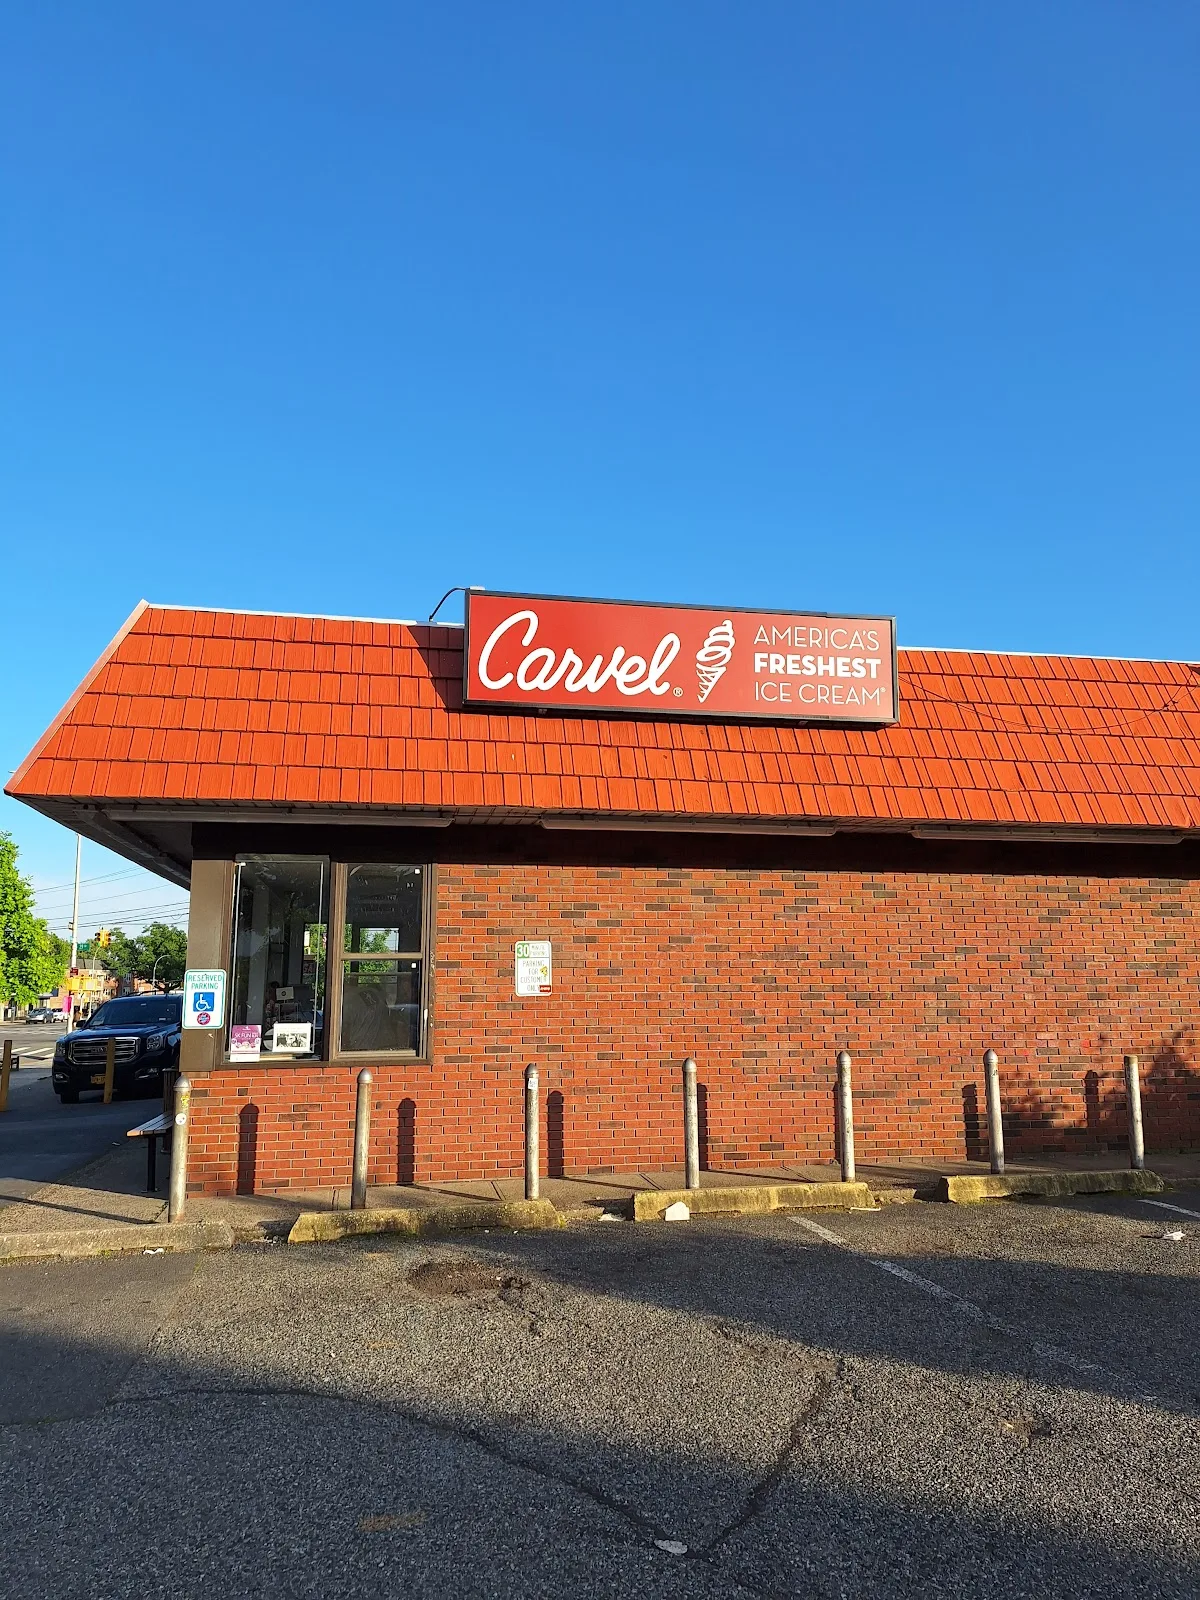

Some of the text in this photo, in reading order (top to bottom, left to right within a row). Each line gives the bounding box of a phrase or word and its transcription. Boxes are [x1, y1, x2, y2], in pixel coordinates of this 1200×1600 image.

[753, 624, 880, 651] AMERICA'S
[478, 609, 681, 696] Carvel
[754, 652, 882, 679] FRESHEST
[755, 681, 792, 703] ICE
[517, 944, 529, 957] 30
[188, 974, 223, 982] RESERVED
[191, 982, 219, 990] PARKING
